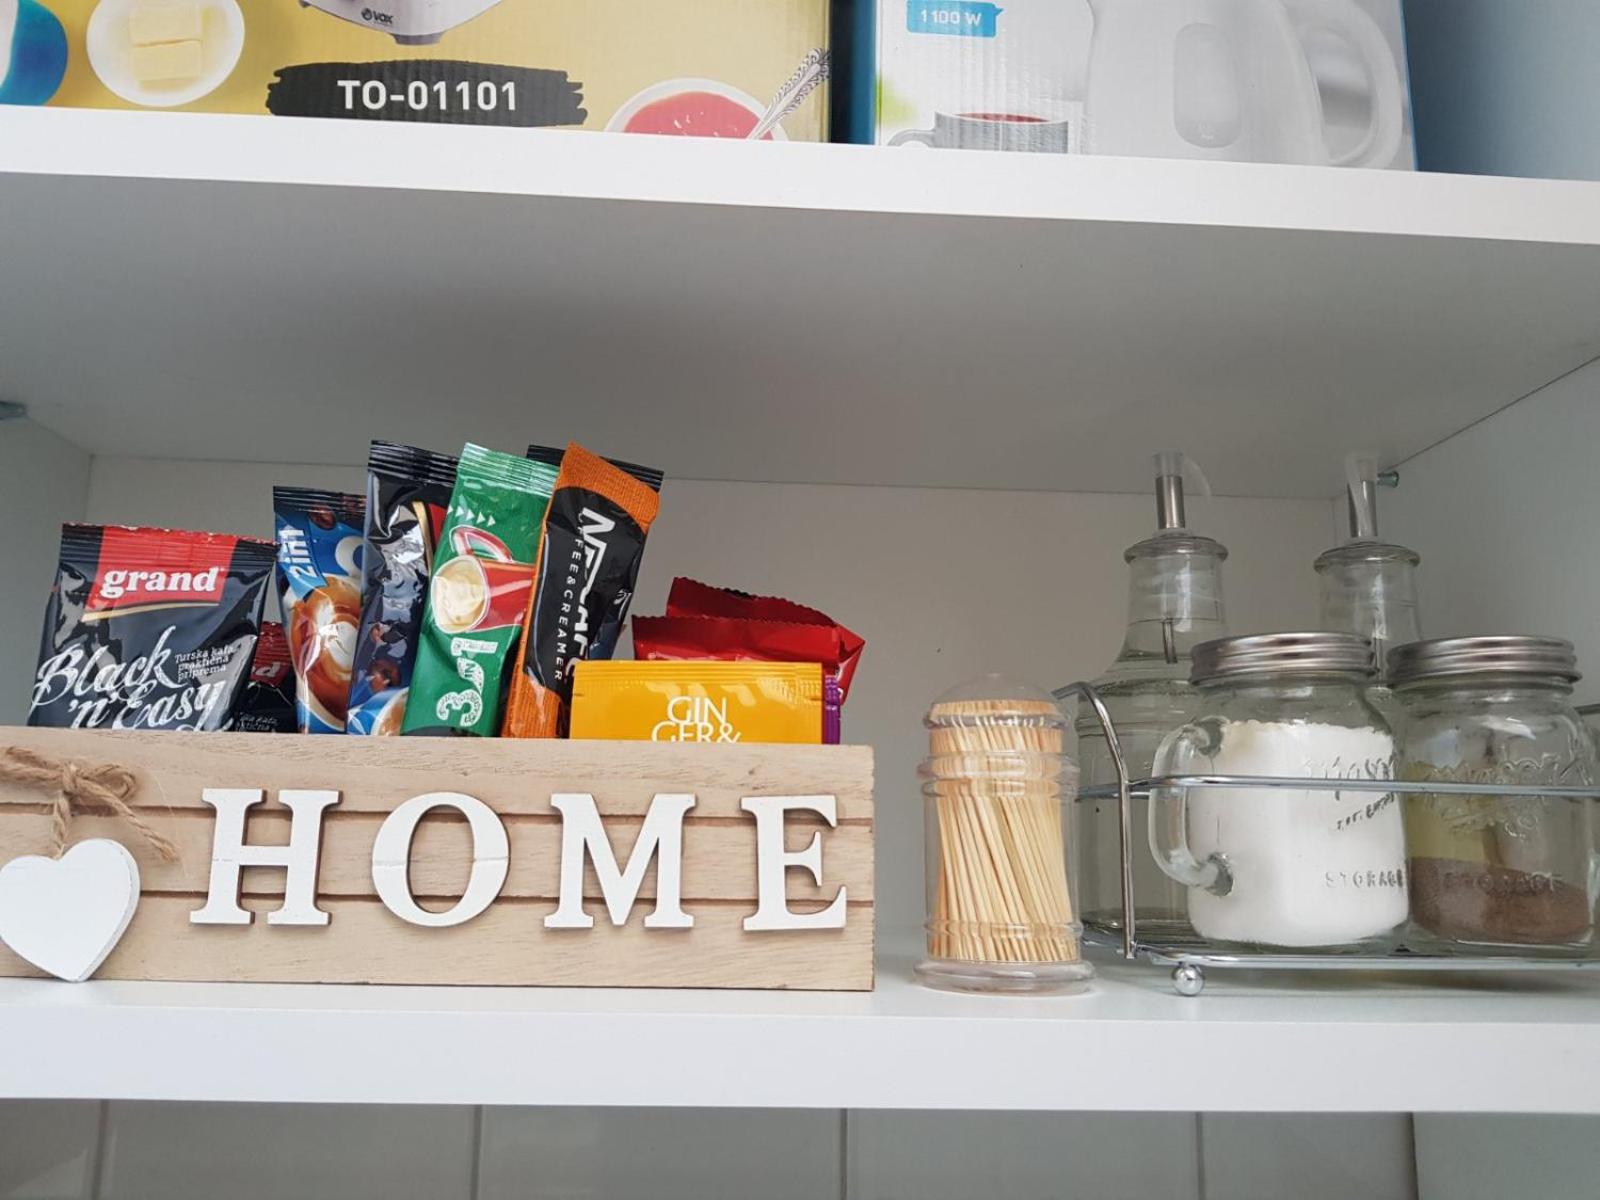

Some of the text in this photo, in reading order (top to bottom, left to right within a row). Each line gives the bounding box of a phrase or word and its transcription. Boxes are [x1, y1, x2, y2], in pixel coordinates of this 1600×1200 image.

[964, 12, 982, 26] W
[336, 79, 517, 111] TO-01101
[99, 566, 219, 599] grand
[30, 625, 188, 714] Black
[666, 695, 728, 725] GIN
[189, 787, 849, 931] HOME
